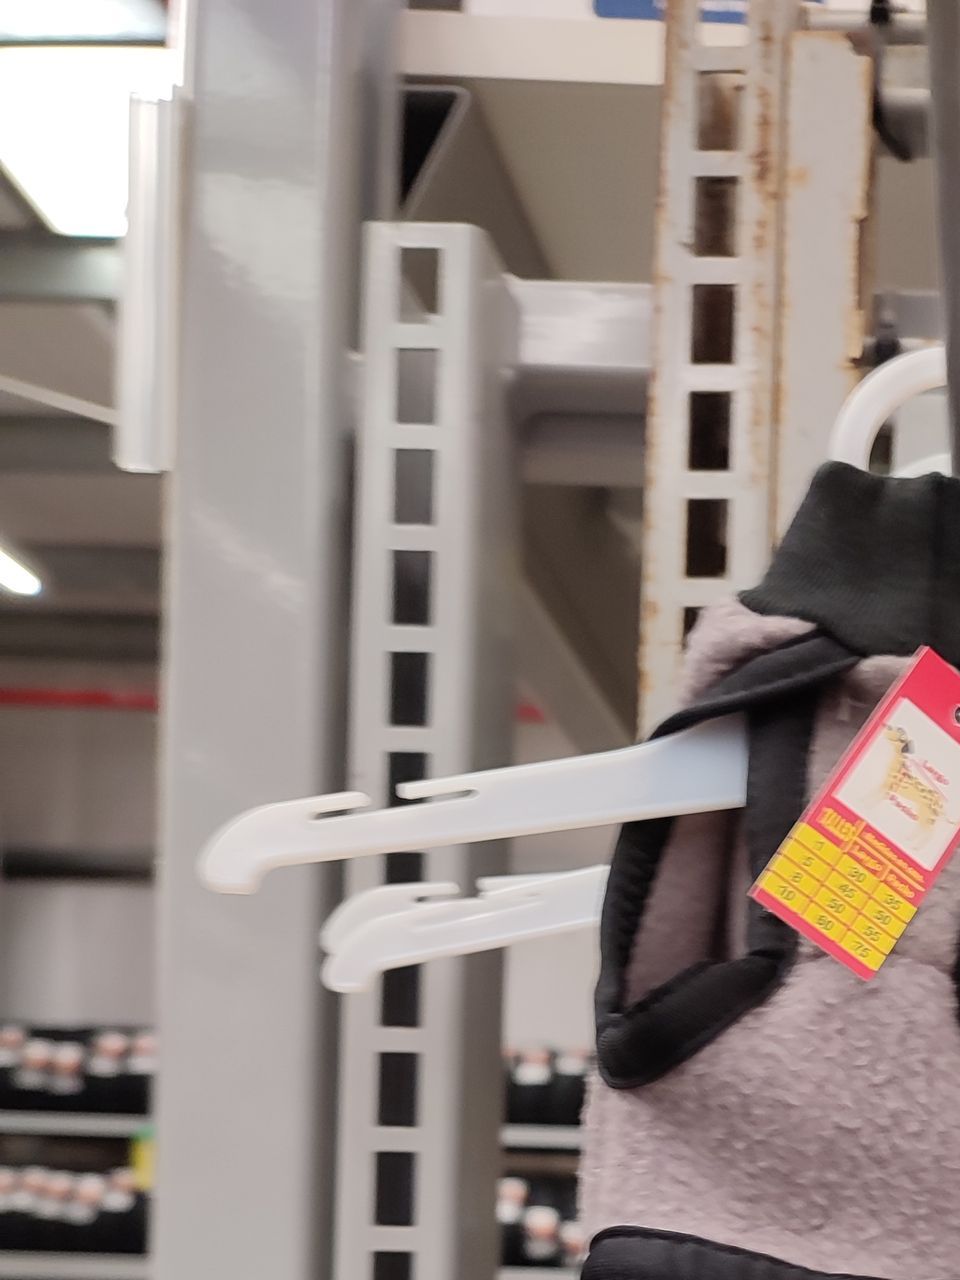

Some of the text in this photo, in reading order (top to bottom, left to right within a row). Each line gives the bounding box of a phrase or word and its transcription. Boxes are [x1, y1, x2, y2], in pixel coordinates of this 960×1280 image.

[802, 856, 892, 926] 5 45 50
[848, 867, 867, 883] 30
[885, 894, 903, 911] 35
[778, 885, 796, 901] 10
[851, 941, 871, 958] 75
[863, 926, 881, 942] 55
